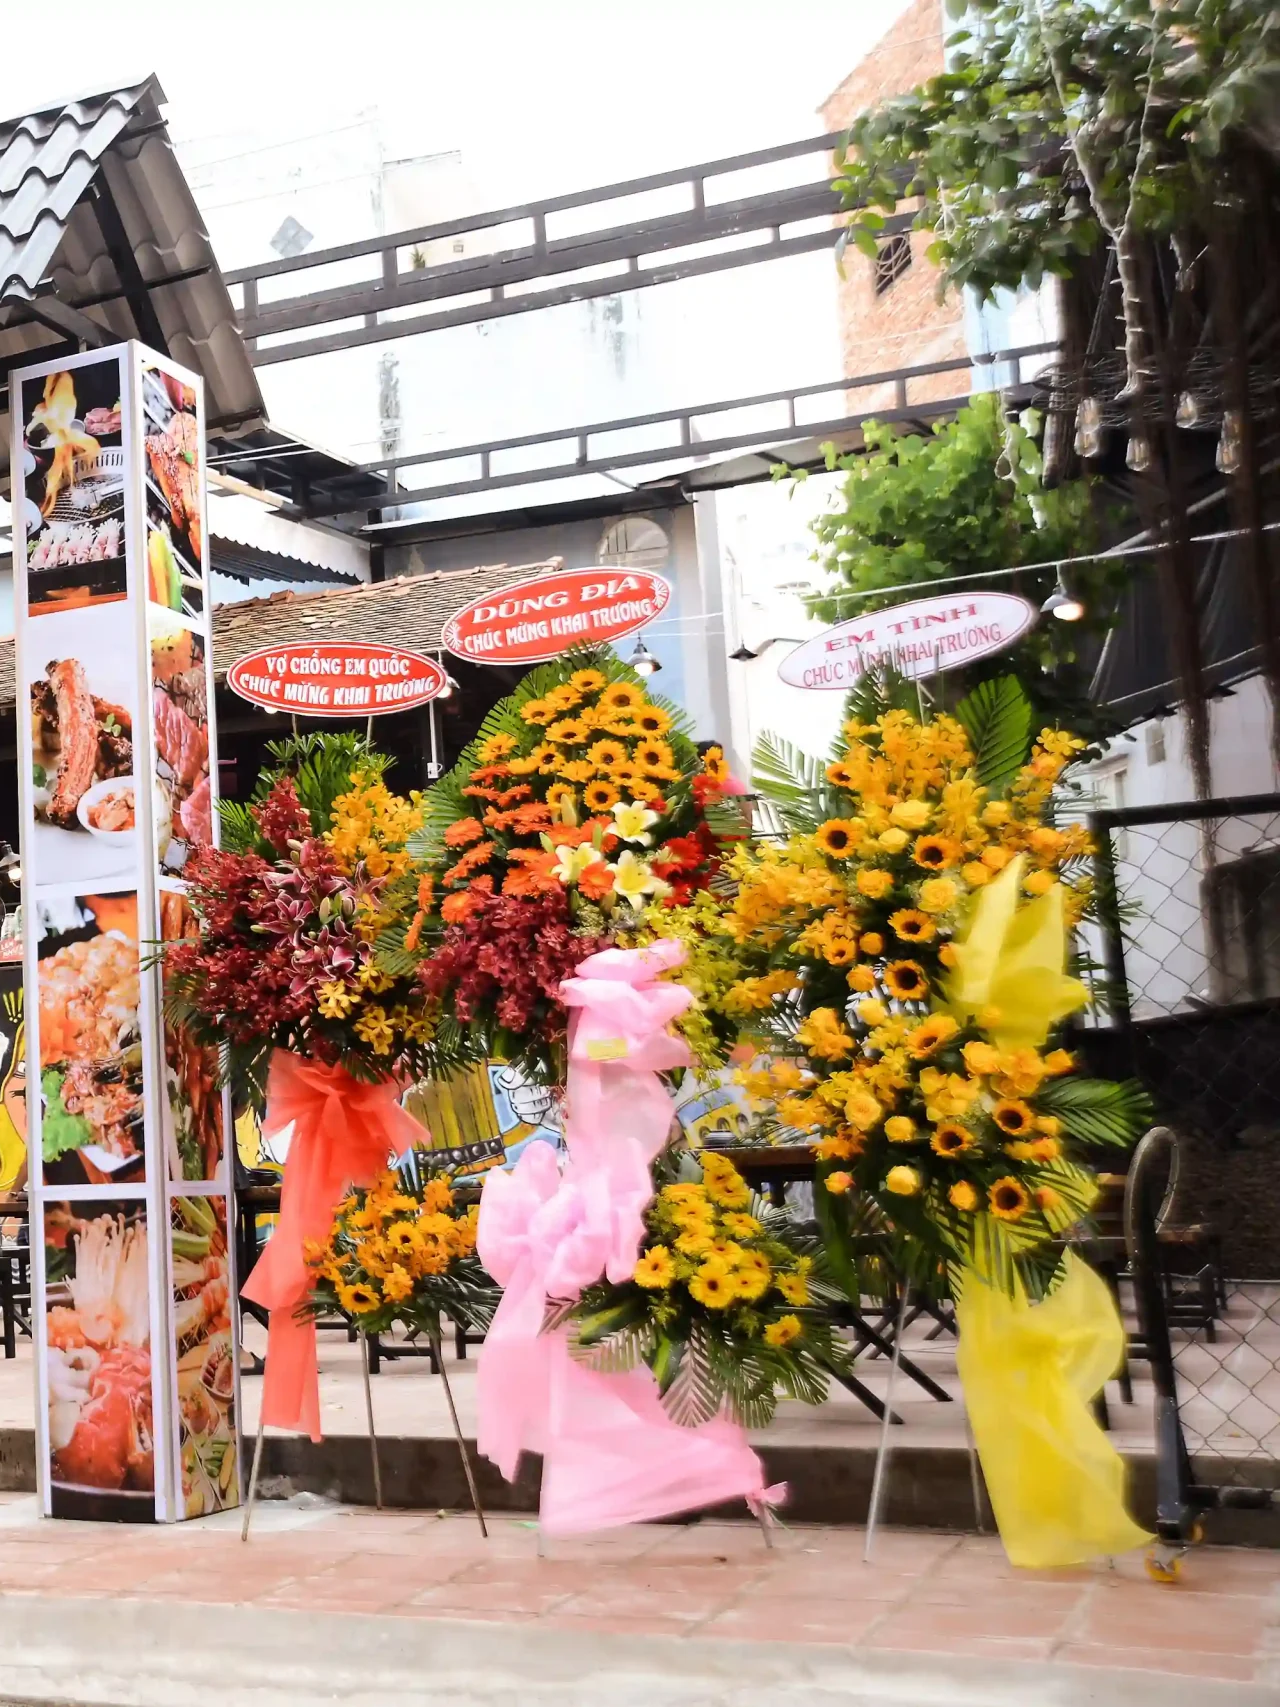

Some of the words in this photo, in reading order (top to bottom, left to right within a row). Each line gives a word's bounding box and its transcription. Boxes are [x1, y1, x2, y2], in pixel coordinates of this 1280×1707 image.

[472, 590, 569, 624] DŨNG
[580, 576, 640, 602] ĐỊA
[464, 629, 503, 654] CHÚC
[506, 621, 548, 645] MỪNG
[551, 613, 588, 635] KHAI
[590, 599, 652, 628] TRƯƠNG
[824, 629, 876, 652] EM
[886, 603, 978, 635] TÌNH
[265, 653, 287, 677] VỢ
[290, 649, 341, 676] CHỒNG
[344, 658, 366, 675] EM
[368, 651, 410, 678] QUỐC
[803, 659, 844, 688] CHÚC
[936, 622, 1001, 656] TRƯƠNG
[239, 672, 281, 698] CHÚC
[284, 681, 329, 704] MỪNG
[333, 686, 370, 706] KHAI
[375, 675, 436, 702] TRƯƠNG
